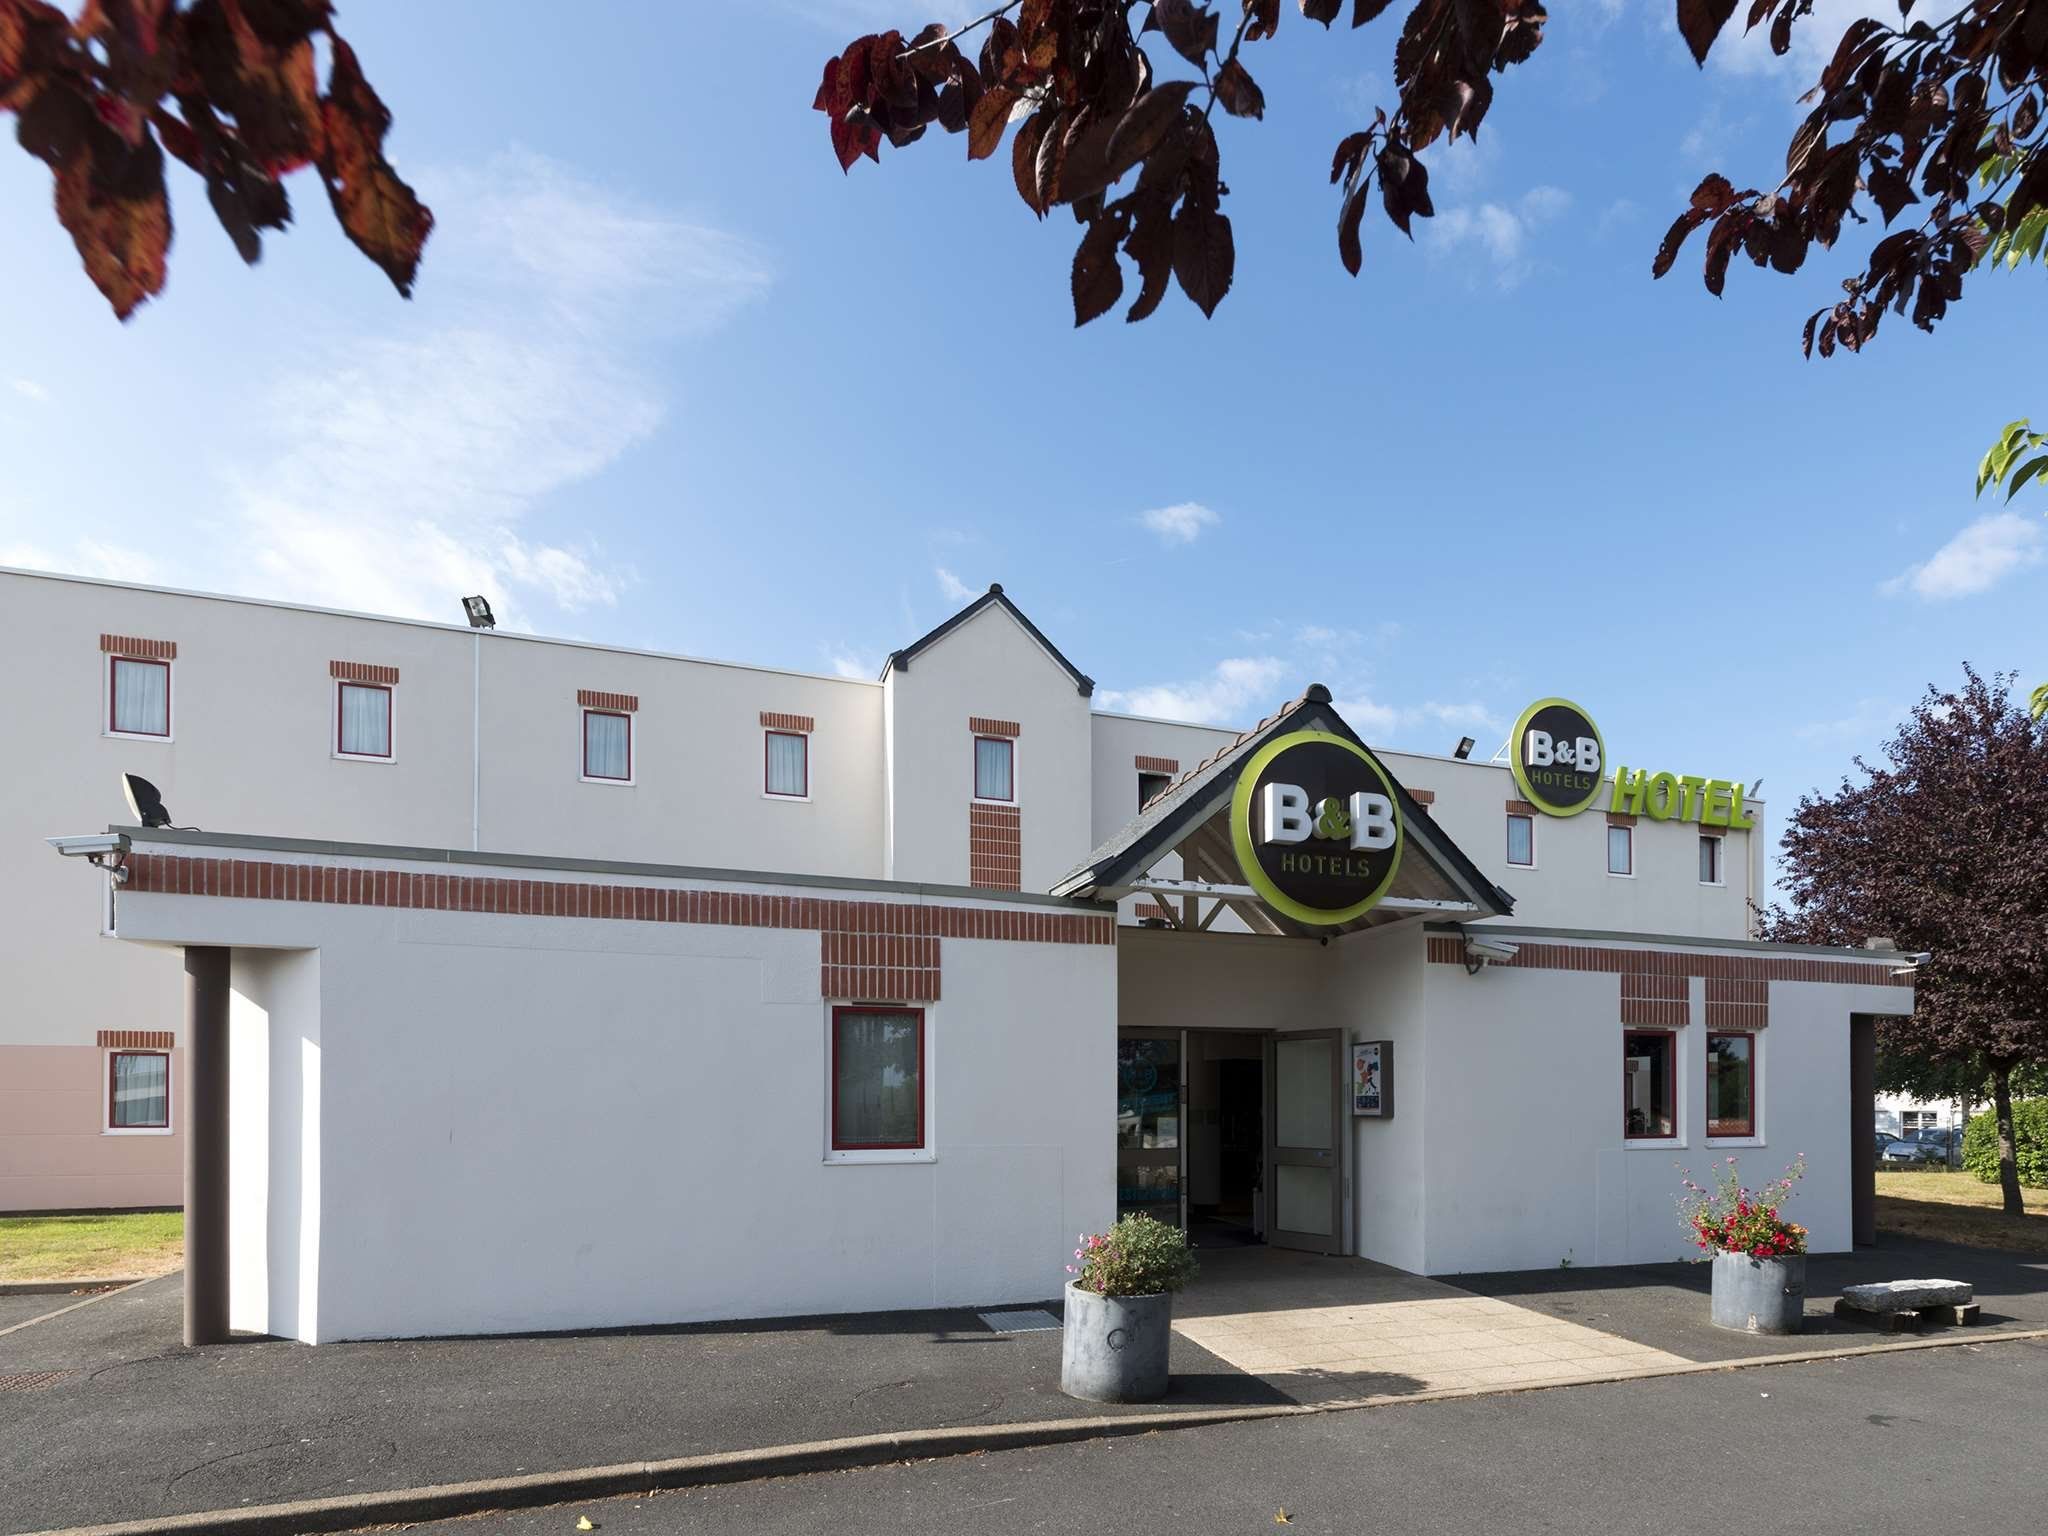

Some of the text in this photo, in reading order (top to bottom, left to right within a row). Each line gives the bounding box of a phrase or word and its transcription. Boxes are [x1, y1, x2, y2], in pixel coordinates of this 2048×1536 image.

[1527, 729, 1600, 773] B&B
[1532, 770, 1592, 790] HOTELS
[1610, 766, 1755, 830] HOTEL
[1264, 782, 1397, 850] B&B
[1281, 853, 1370, 877] HOTELS
